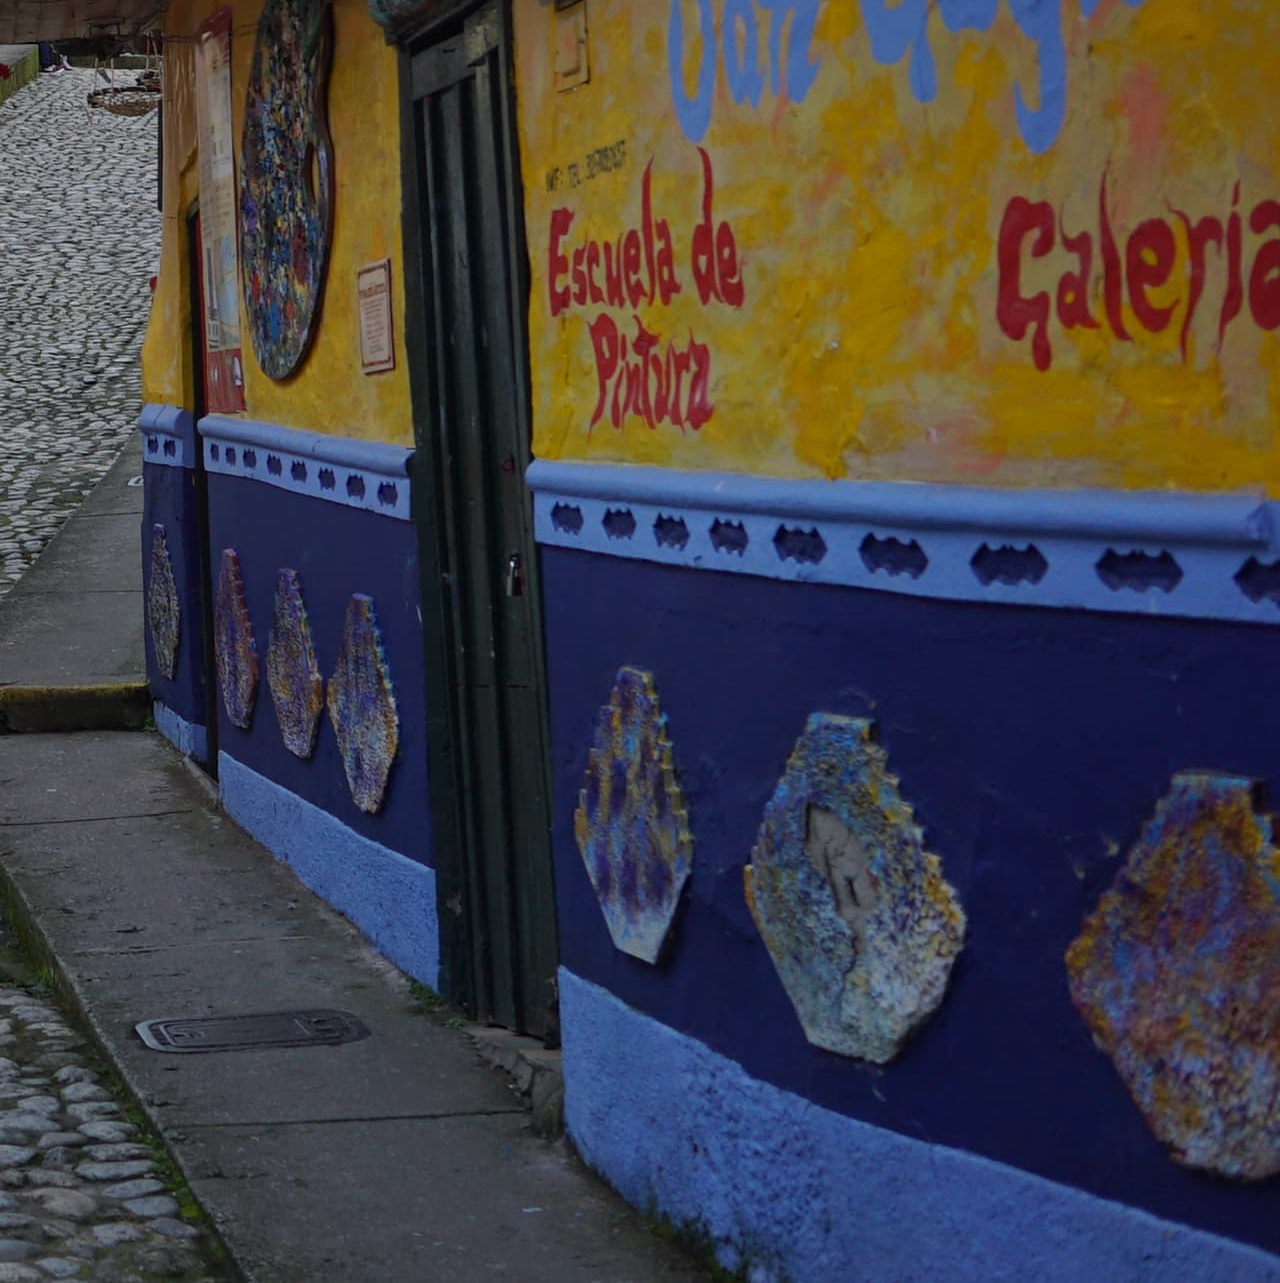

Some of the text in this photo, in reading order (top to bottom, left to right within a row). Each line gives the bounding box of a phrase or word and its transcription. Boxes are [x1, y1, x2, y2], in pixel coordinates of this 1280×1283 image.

[549, 146, 744, 317] Escuela de
[586, 313, 714, 440] Pintura
